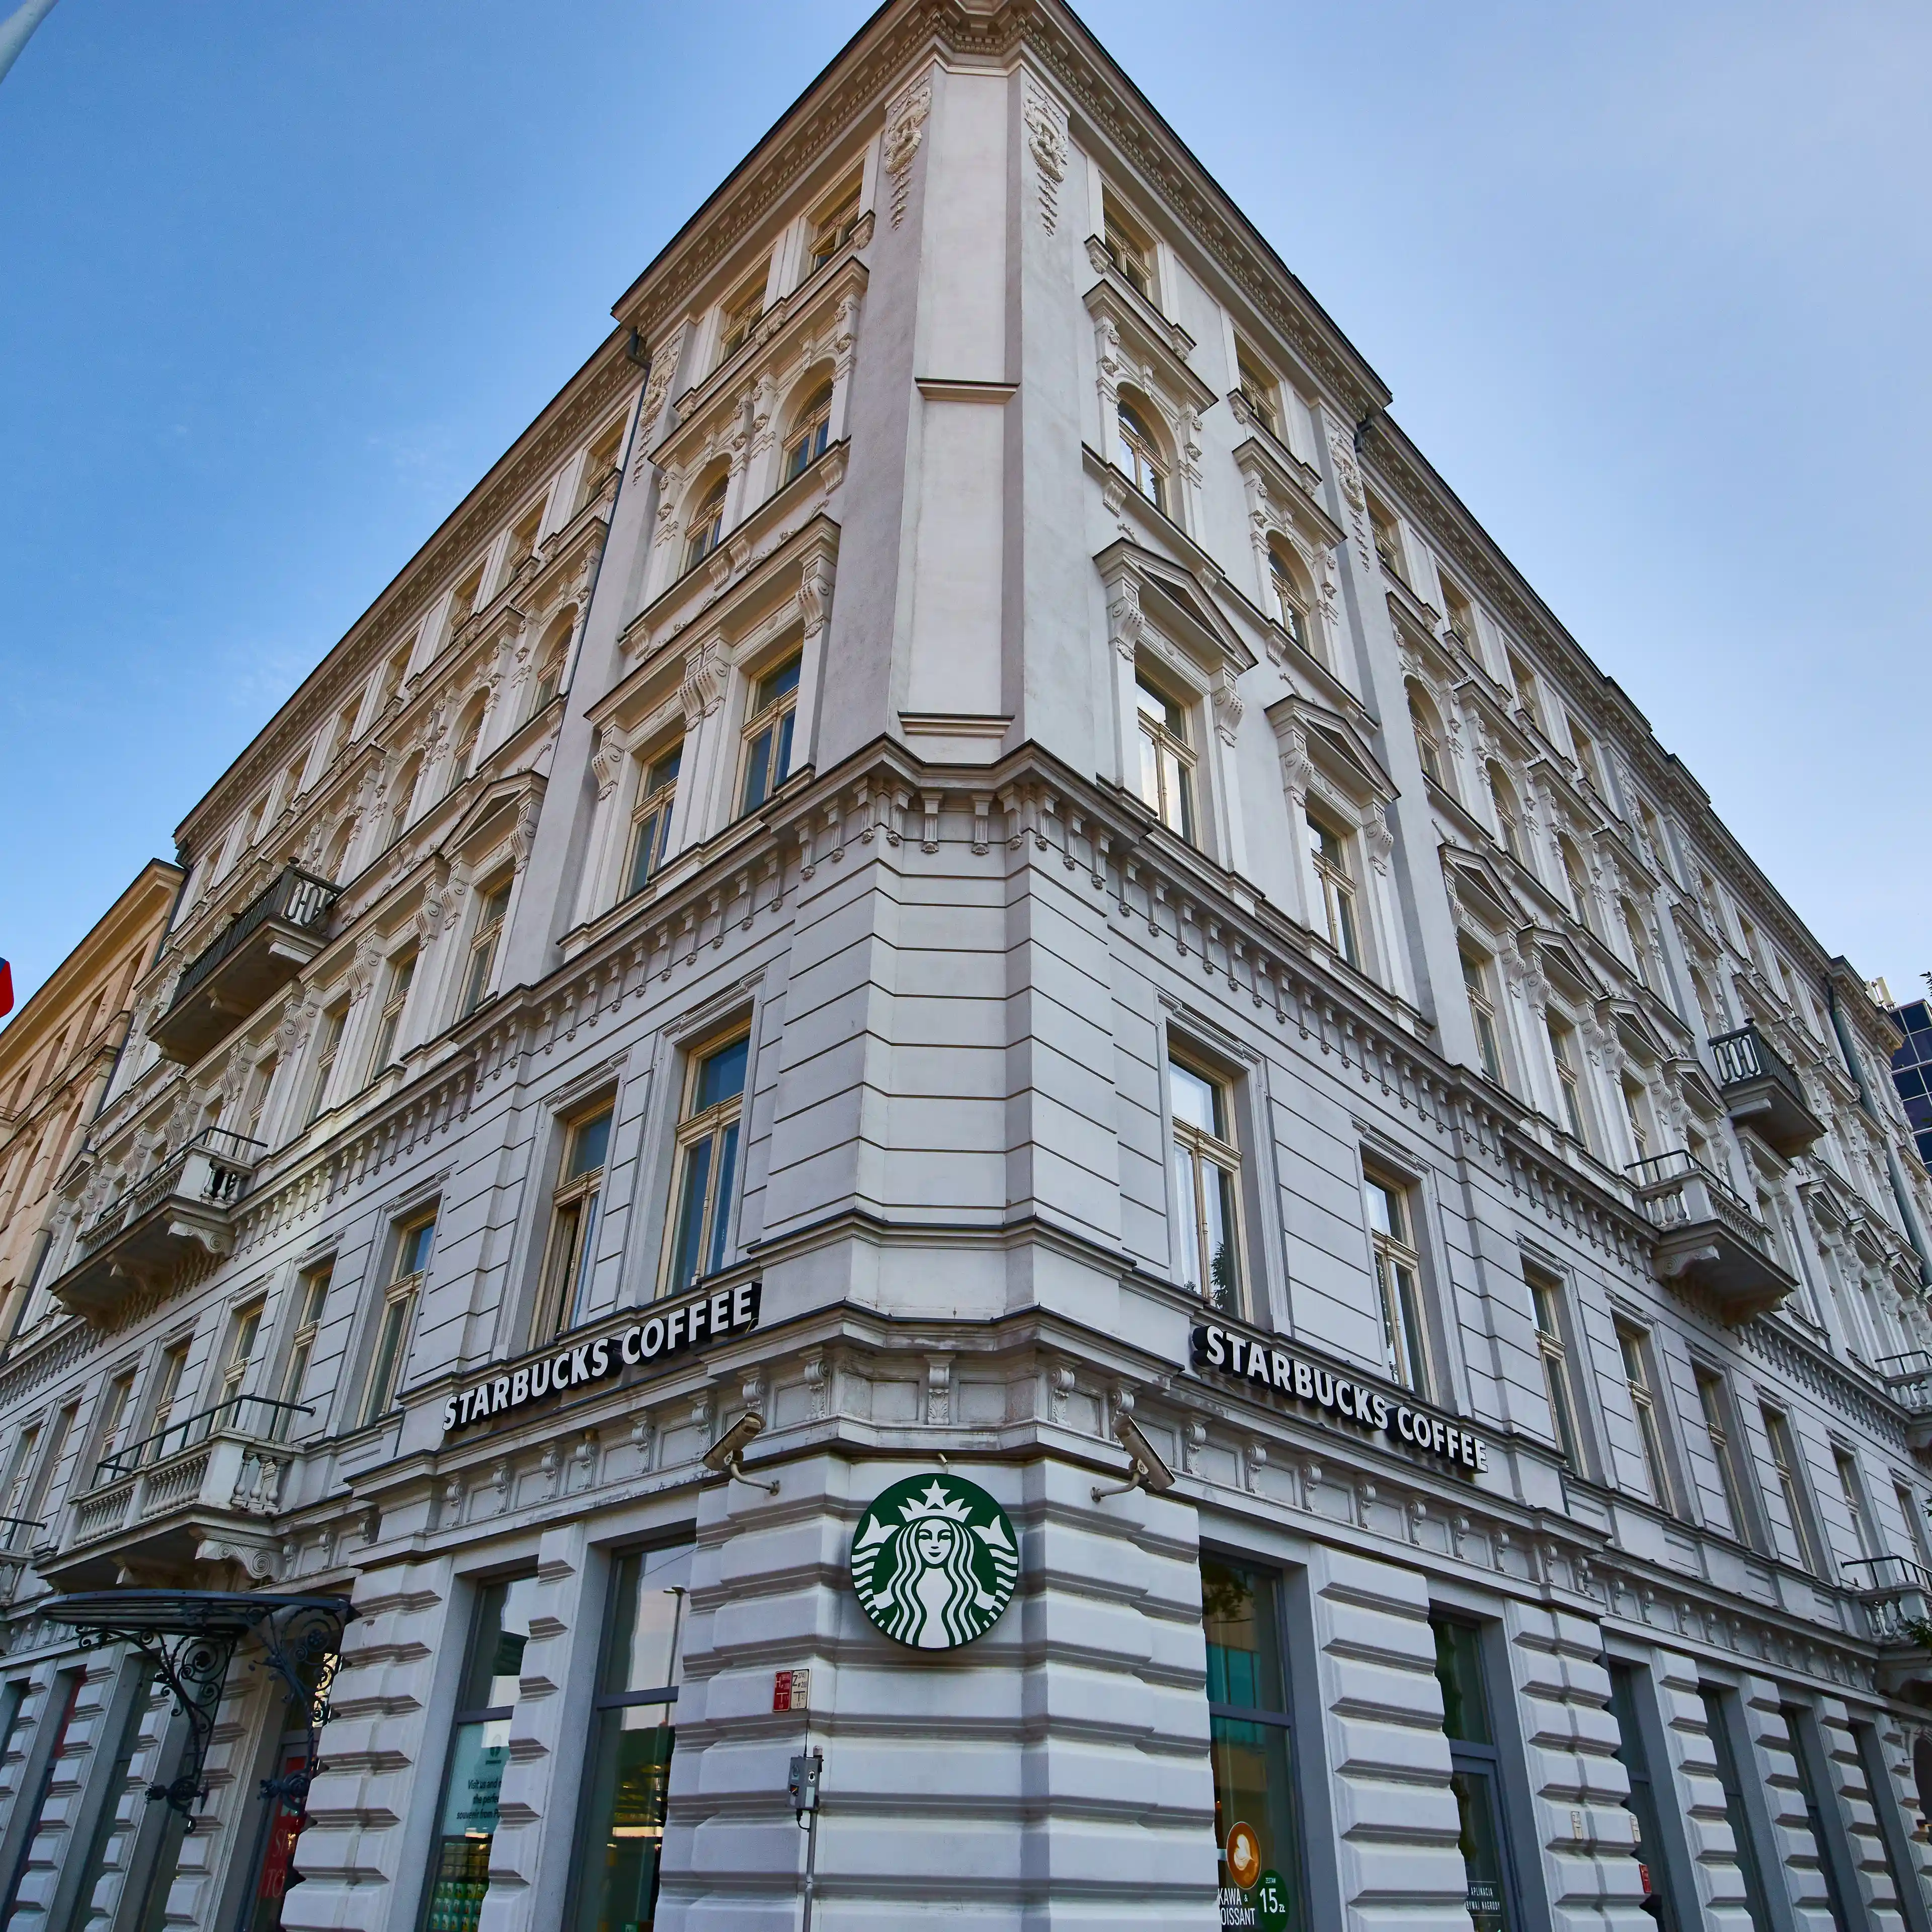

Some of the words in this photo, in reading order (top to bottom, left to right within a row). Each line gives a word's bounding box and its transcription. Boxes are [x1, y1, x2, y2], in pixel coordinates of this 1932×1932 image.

[443, 1338, 609, 1431] STARBUCKS
[622, 1282, 753, 1365] COFFEE
[1206, 1325, 1388, 1430] STARBUCKS
[1397, 1406, 1488, 1474] COFFEE
[775, 1676, 781, 1688] H
[792, 1674, 798, 1686] Z
[468, 1779, 479, 1790] Visit
[479, 1781, 487, 1789] us
[487, 1777, 499, 1789] and
[473, 1794, 481, 1804] the
[456, 1809, 479, 1819] souvenir
[480, 1808, 493, 1819] from
[1218, 1888, 1242, 1905] KAWA
[1243, 1894, 1248, 1902] &
[1259, 1888, 1278, 1913] 15
[1466, 1900, 1480, 1910] BYWAJ
[1221, 1907, 1255, 1925] OISSANT
